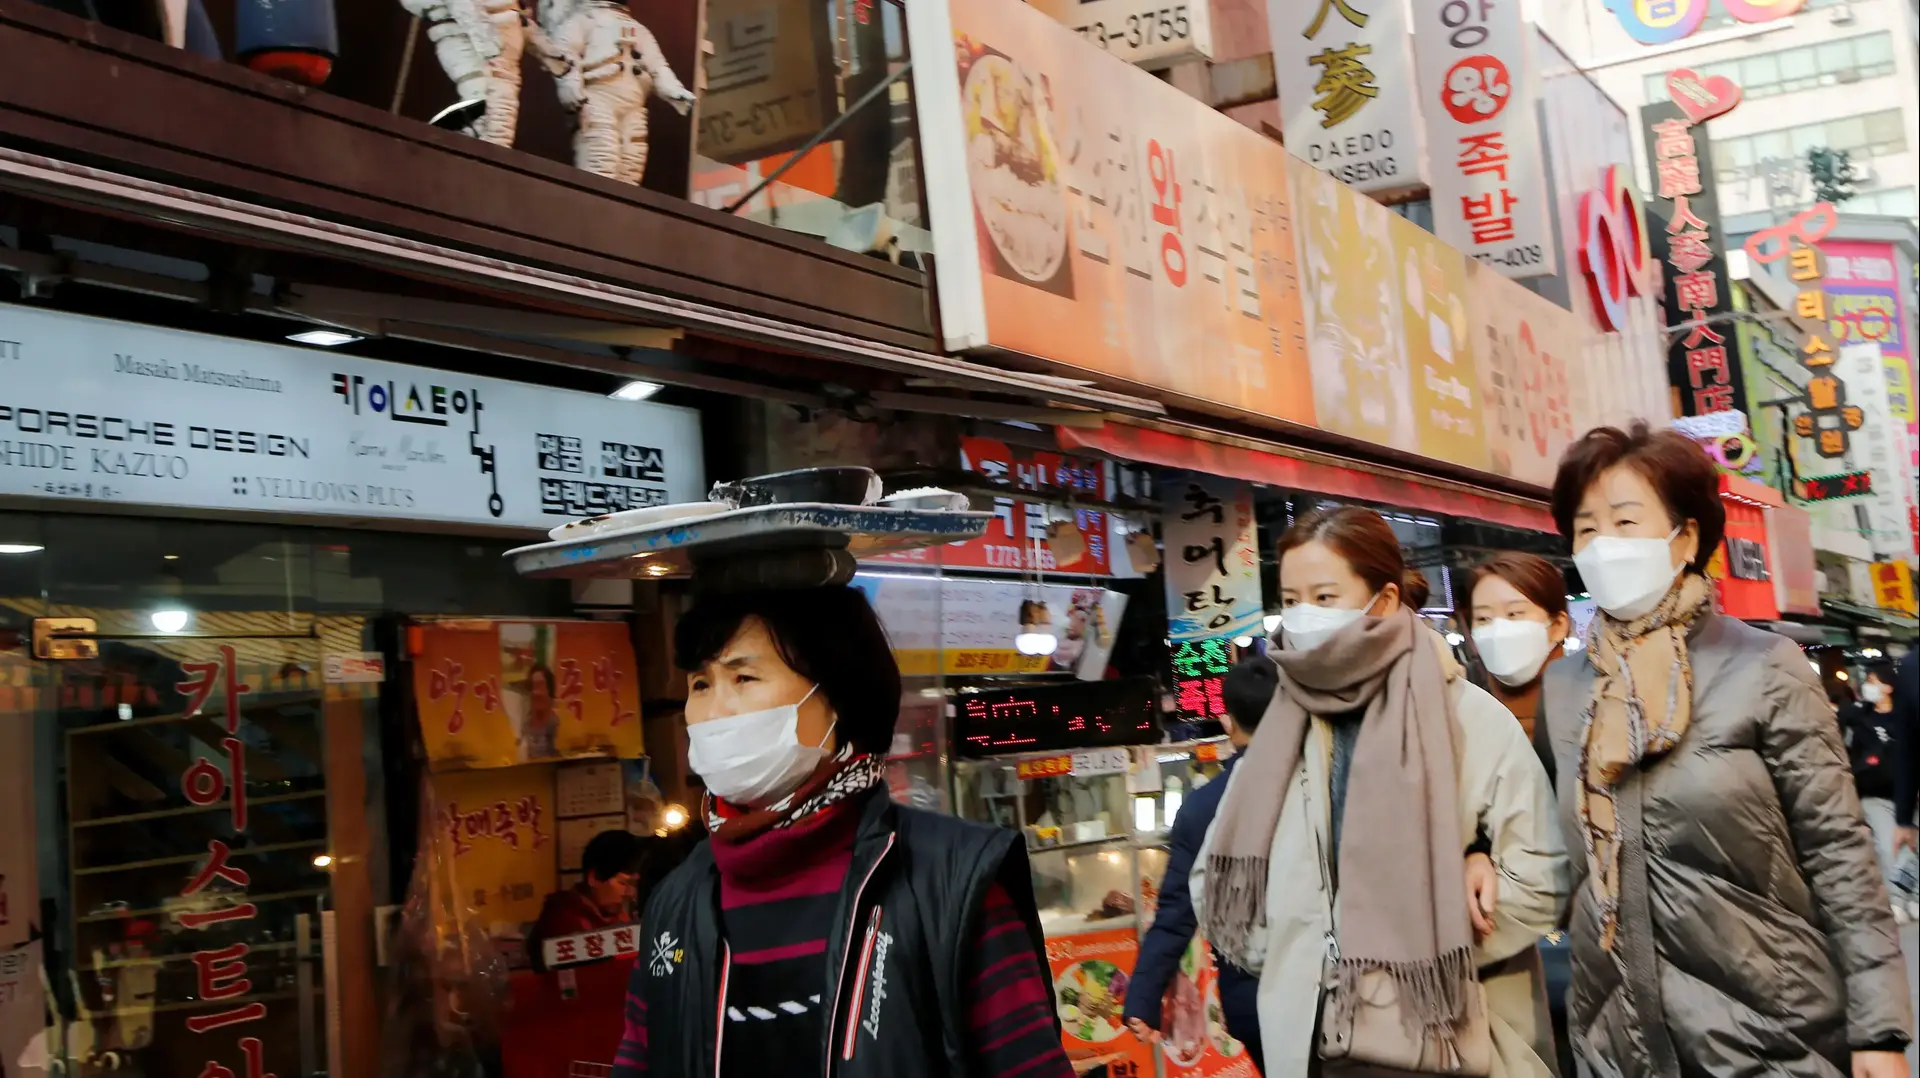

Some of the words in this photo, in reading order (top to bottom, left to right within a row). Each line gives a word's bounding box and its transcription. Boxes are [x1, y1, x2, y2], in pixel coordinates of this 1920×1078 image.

[1309, 129, 1394, 163] DAEDO
[1456, 131, 1519, 245] 족발
[113, 353, 178, 379] Masaki
[0, 405, 176, 446] PORSCHE
[188, 426, 310, 459] DESIGN
[90, 448, 188, 480] KAZUO
